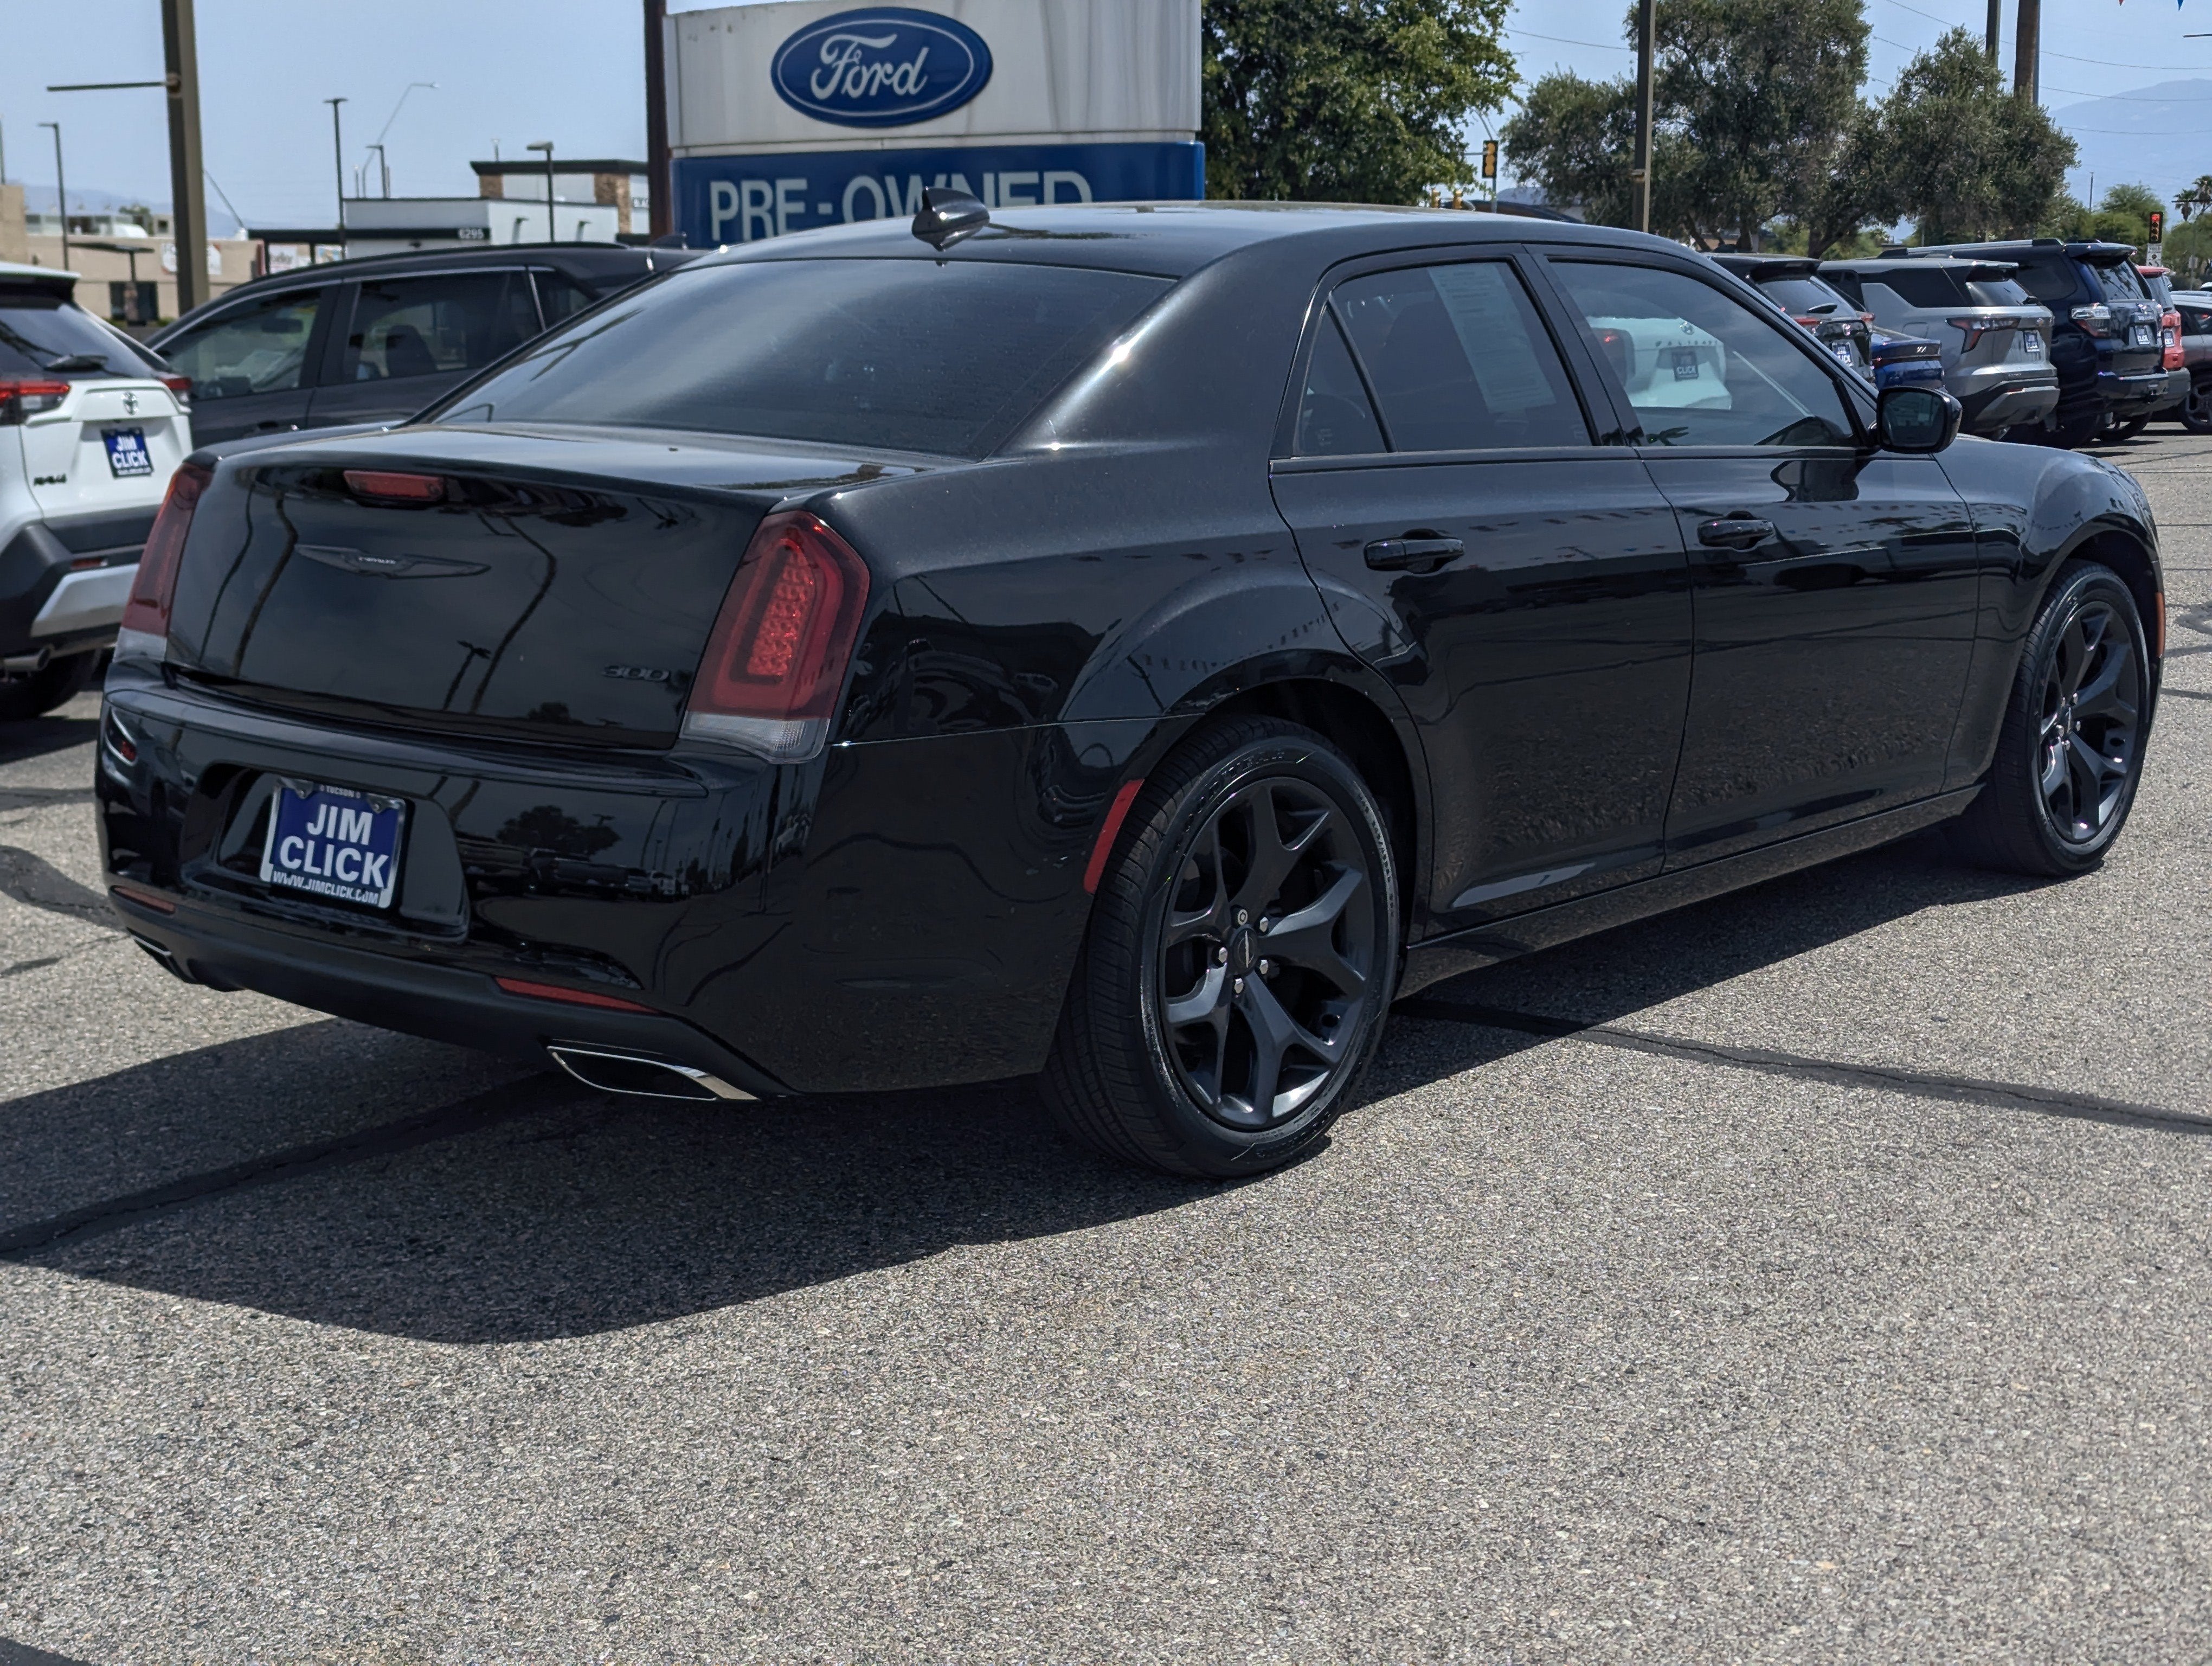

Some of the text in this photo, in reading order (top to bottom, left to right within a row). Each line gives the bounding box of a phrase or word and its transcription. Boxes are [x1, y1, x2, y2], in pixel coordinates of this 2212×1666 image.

[811, 33, 929, 100] Ford
[112, 450, 149, 469] CLICK
[116, 435, 138, 451] JIM
[326, 785, 355, 798] TUCSON
[306, 803, 374, 845] JIM
[279, 835, 389, 888] CLICK
[273, 870, 380, 905] WWW.JIMCLICK.COM
